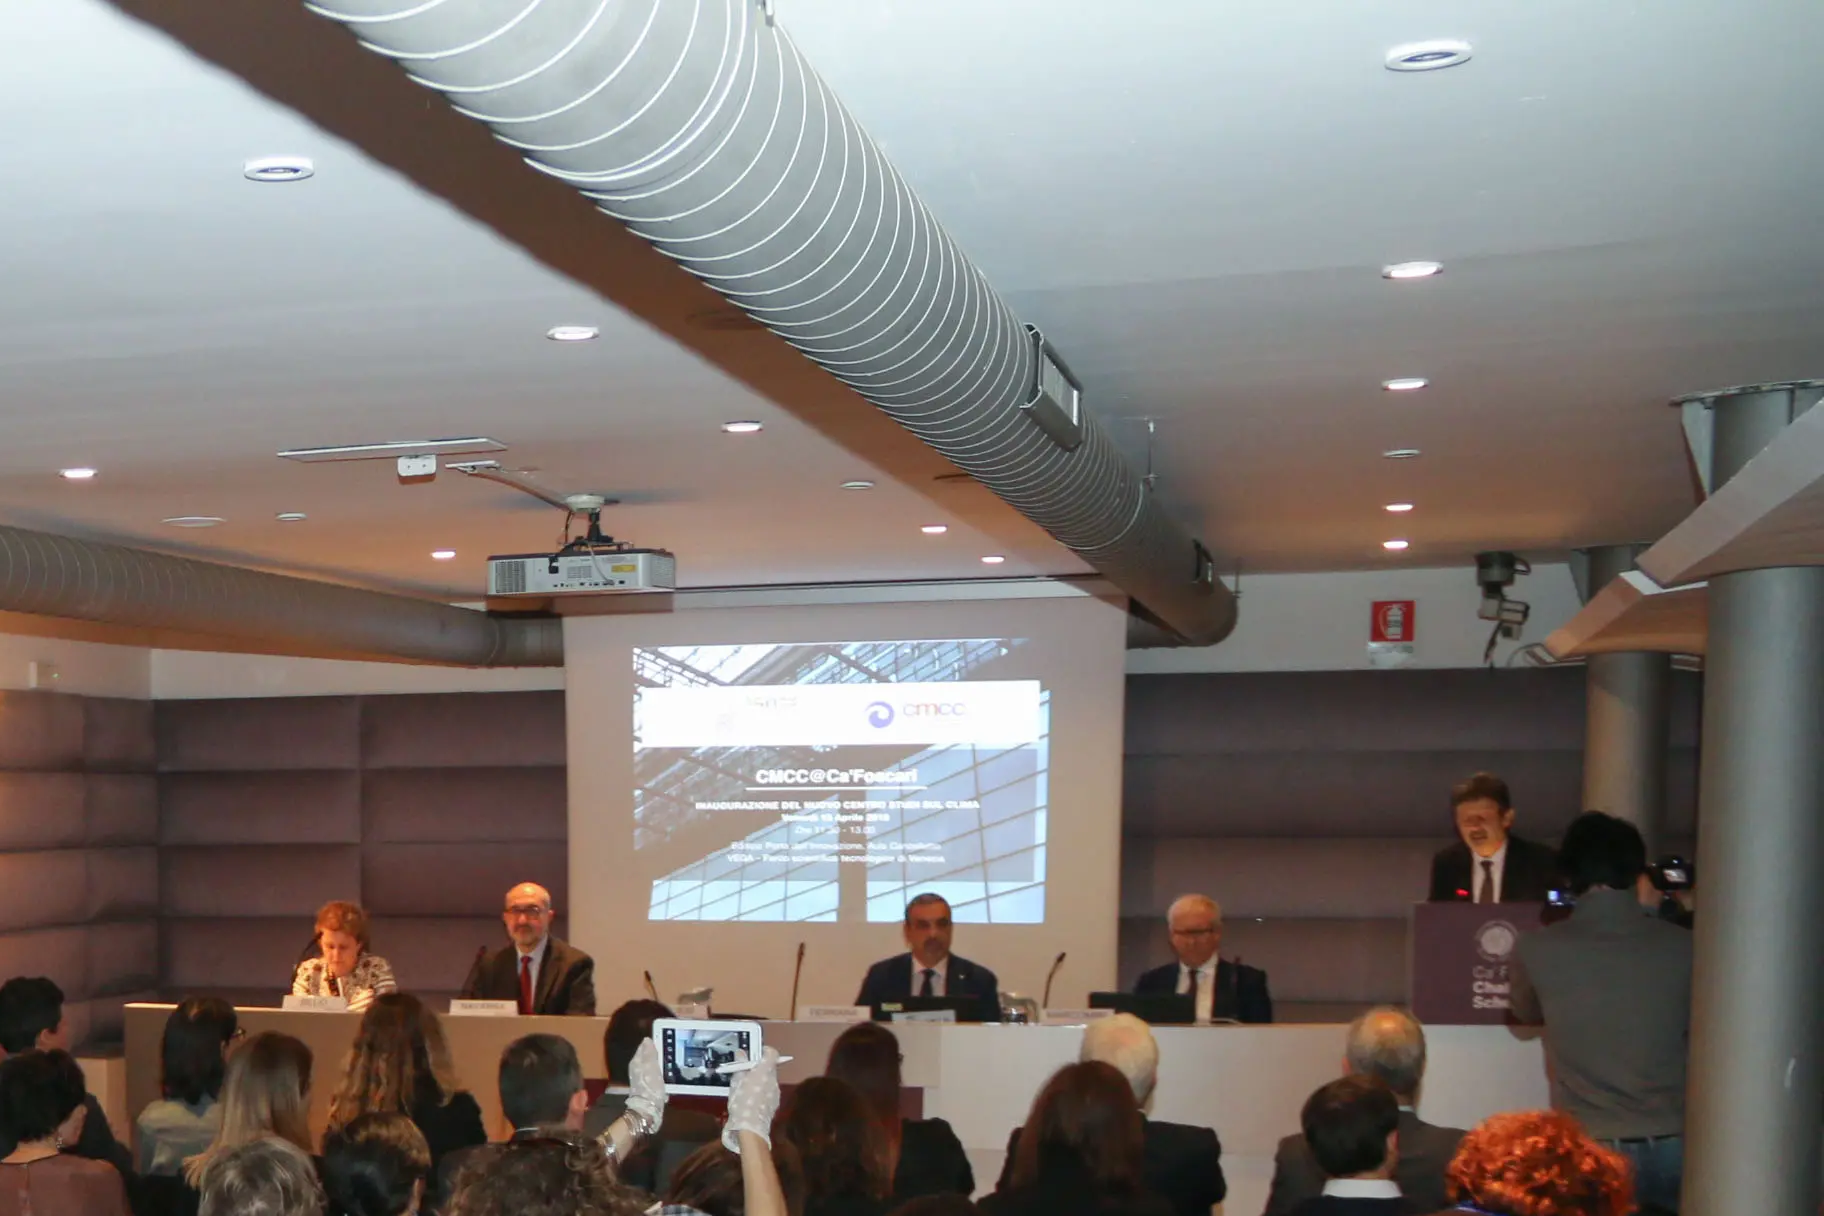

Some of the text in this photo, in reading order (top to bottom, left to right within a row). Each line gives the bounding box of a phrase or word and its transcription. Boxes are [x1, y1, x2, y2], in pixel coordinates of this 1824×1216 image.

[902, 702, 966, 716] cmcc
[695, 801, 779, 810] INAUGURAZIONE
[781, 801, 802, 810] DEL
